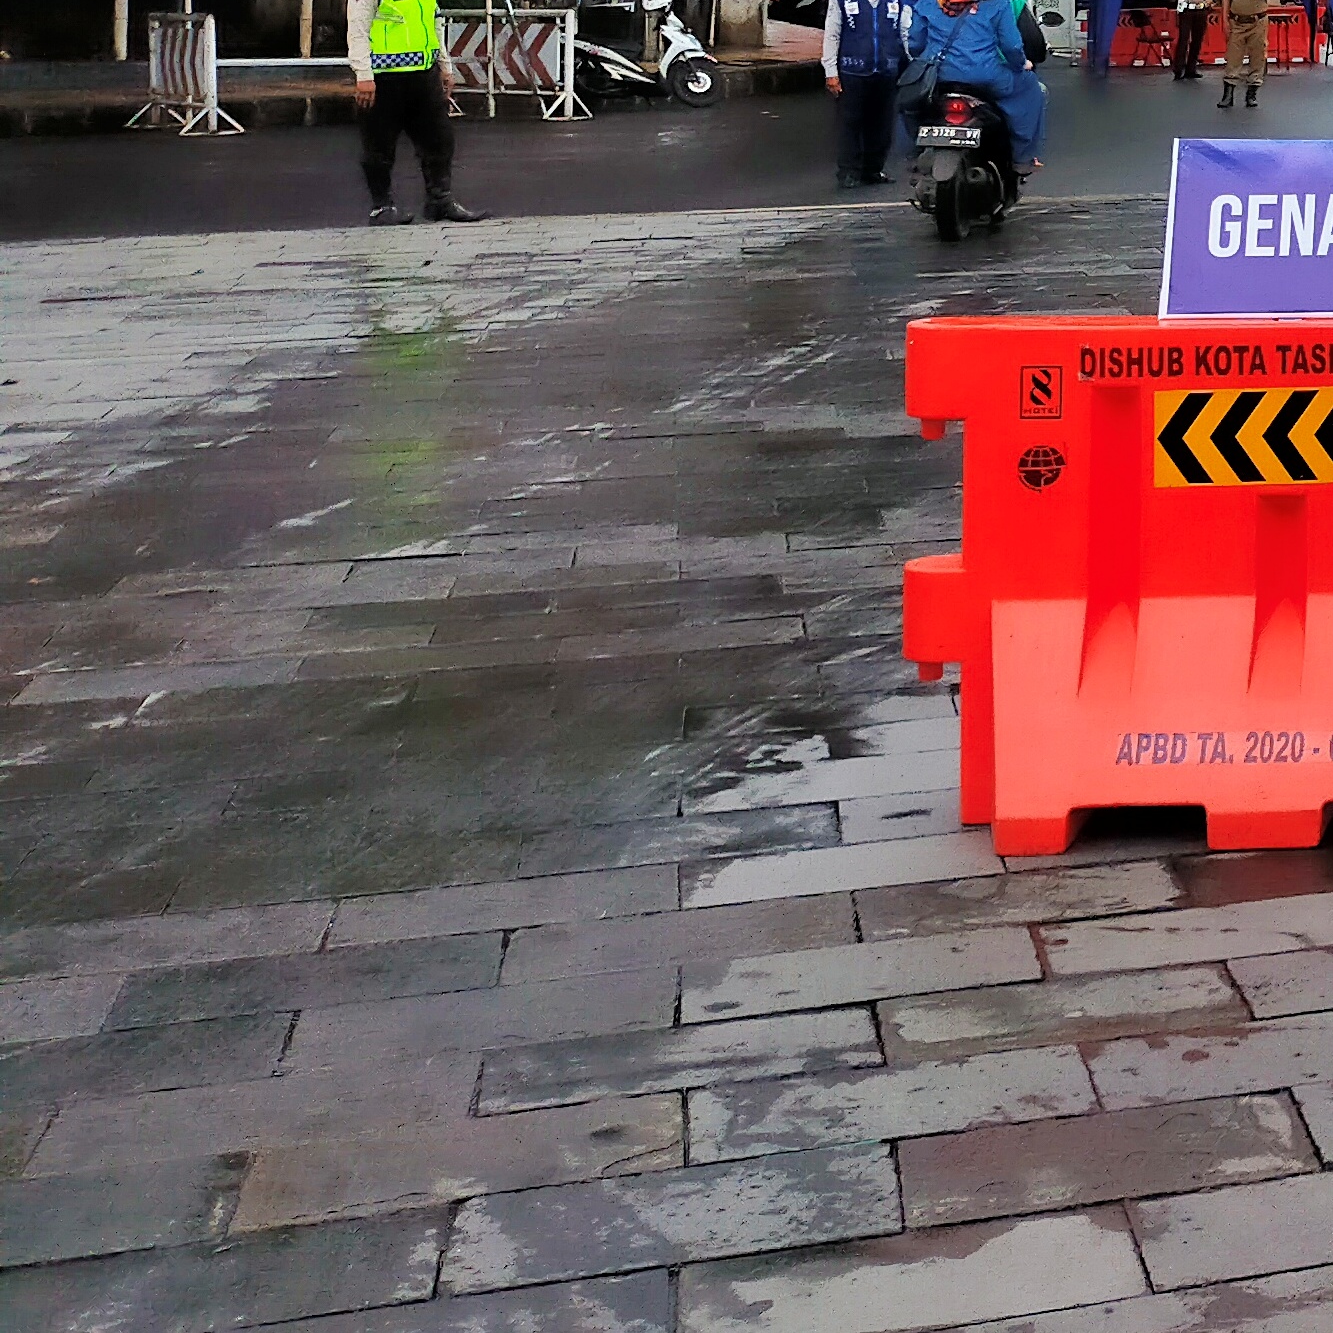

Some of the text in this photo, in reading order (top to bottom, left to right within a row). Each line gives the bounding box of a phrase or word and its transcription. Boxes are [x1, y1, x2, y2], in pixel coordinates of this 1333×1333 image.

[1080, 346, 1184, 379] DISHUB
[1194, 345, 1266, 376] KOTA
[1115, 731, 1188, 766] APBD
[1243, 730, 1305, 764] 2020
